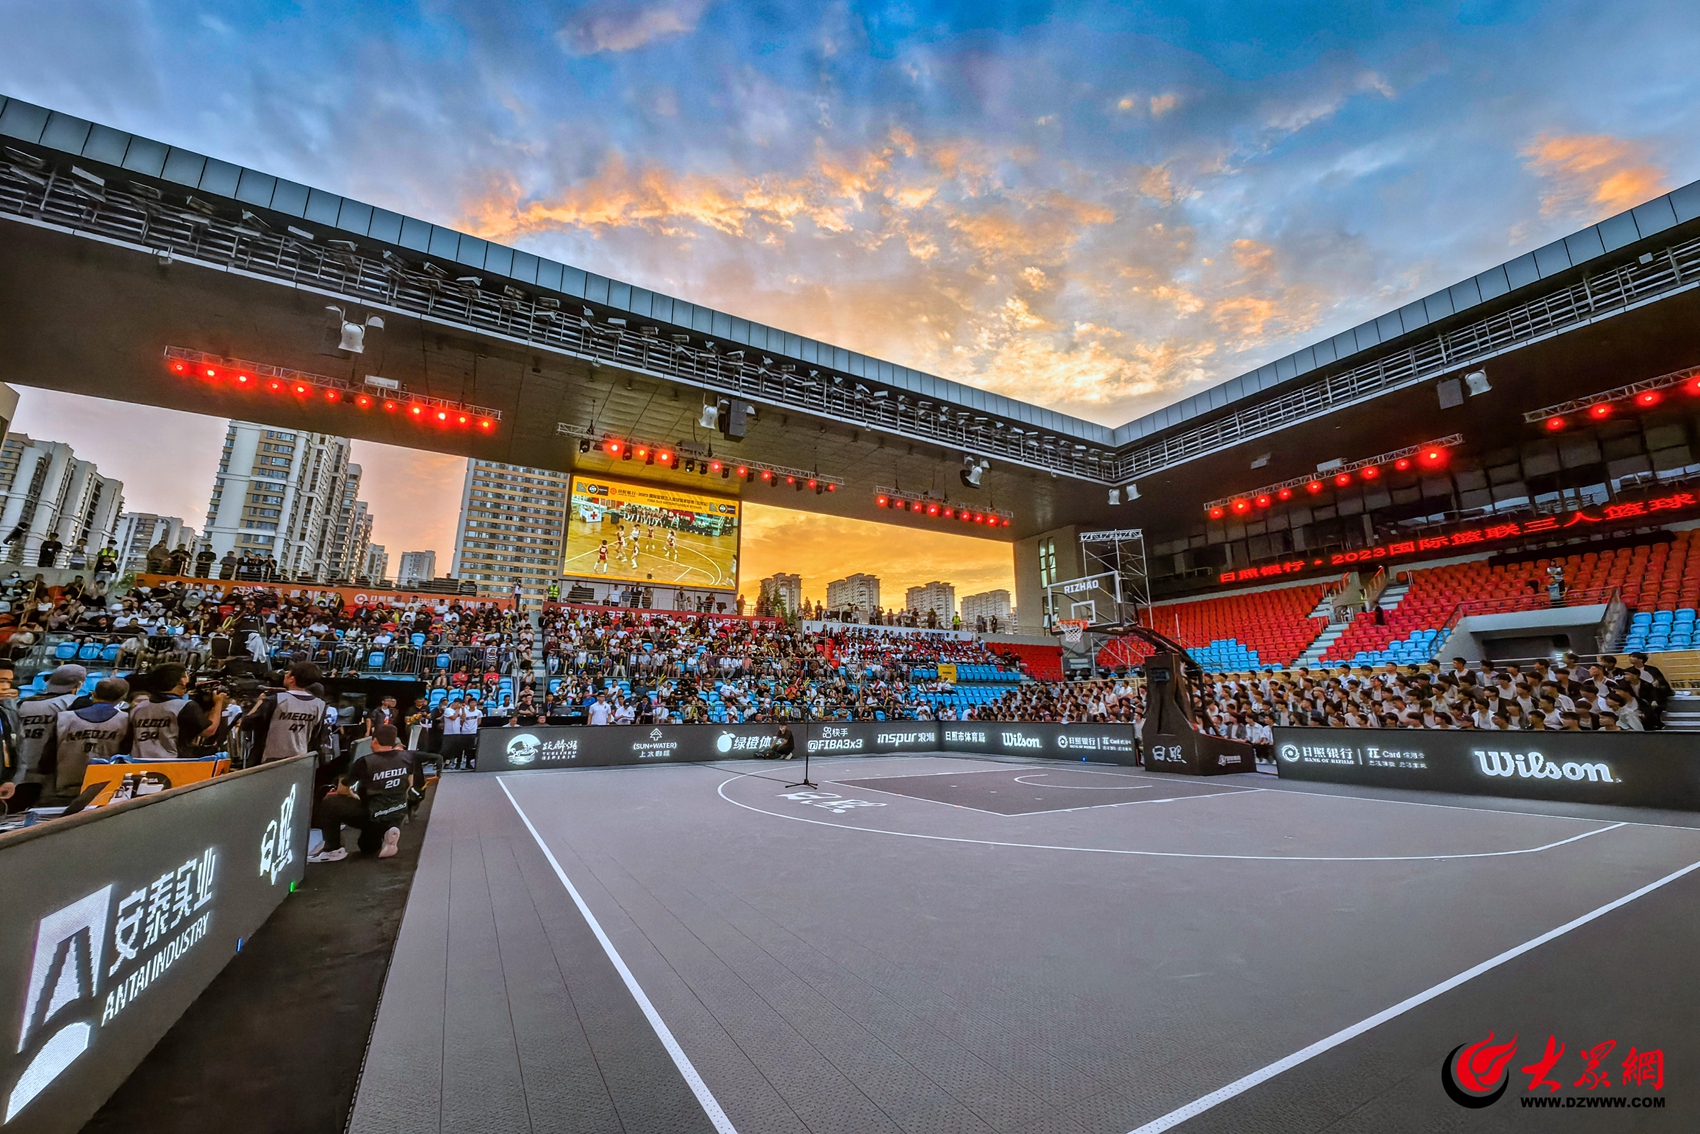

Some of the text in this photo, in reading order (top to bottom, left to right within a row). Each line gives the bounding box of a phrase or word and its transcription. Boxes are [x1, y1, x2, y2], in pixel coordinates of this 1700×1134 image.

[1064, 579, 1099, 594] RIZHAO
[66, 730, 117, 742] MEDIA
[832, 728, 848, 737] 快手
[877, 732, 917, 746] inspur
[945, 731, 986, 743] 日照市体育局
[733, 735, 781, 750] 绿橙体
[808, 738, 863, 752] @FIBA3x3
[1001, 732, 1041, 748] Wilson
[1152, 745, 1187, 764] 日照
[1302, 747, 1353, 759] 日照银行
[1382, 750, 1401, 759] Card
[1474, 750, 1615, 784] Wilson
[372, 767, 407, 782] MEDIA
[384, 778, 401, 790] 20
[101, 911, 210, 1028] ANTAI INDUSTRY
